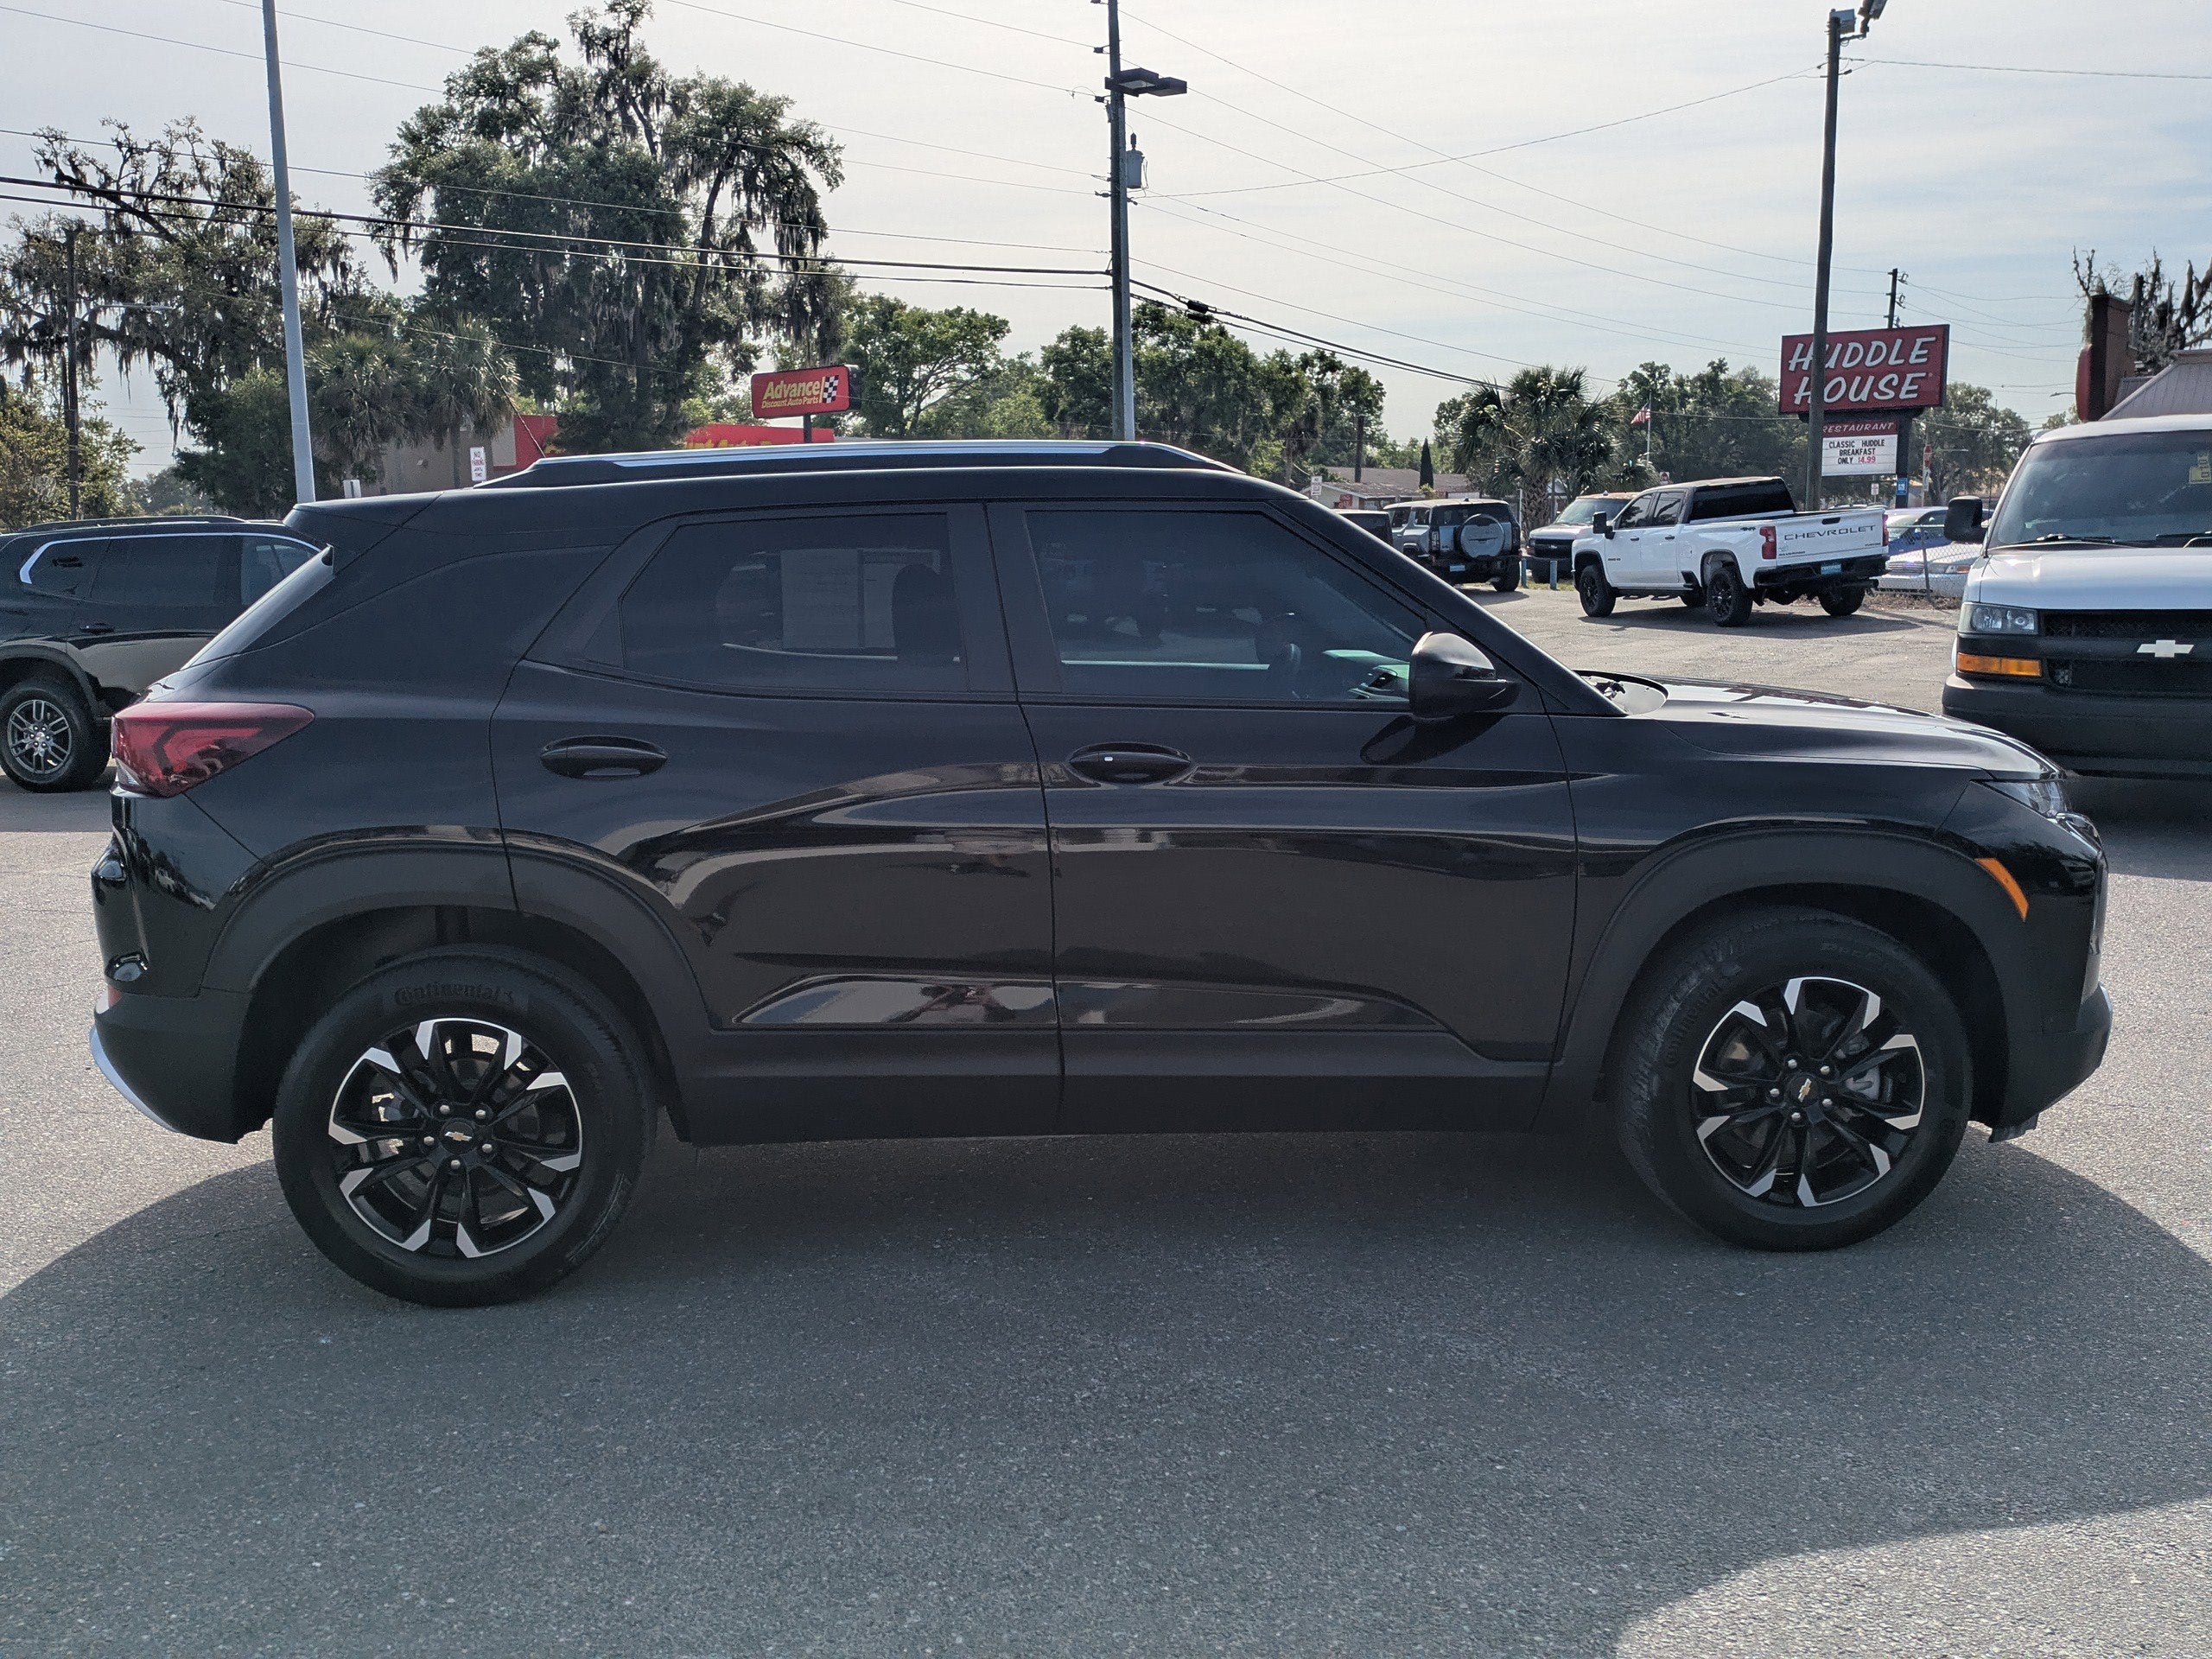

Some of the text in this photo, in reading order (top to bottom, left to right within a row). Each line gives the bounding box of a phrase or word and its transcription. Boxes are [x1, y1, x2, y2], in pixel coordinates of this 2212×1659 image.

[1788, 336, 1936, 372] HUDDLE
[763, 380, 820, 400] Advance
[1794, 372, 1926, 405] HOUSE
[761, 399, 788, 409] Discount
[803, 397, 818, 405] Parts
[1839, 448, 1876, 456] BREAKFAST
[1858, 455, 1876, 464] $4.99
[1784, 524, 1876, 541] CHEVROLET
